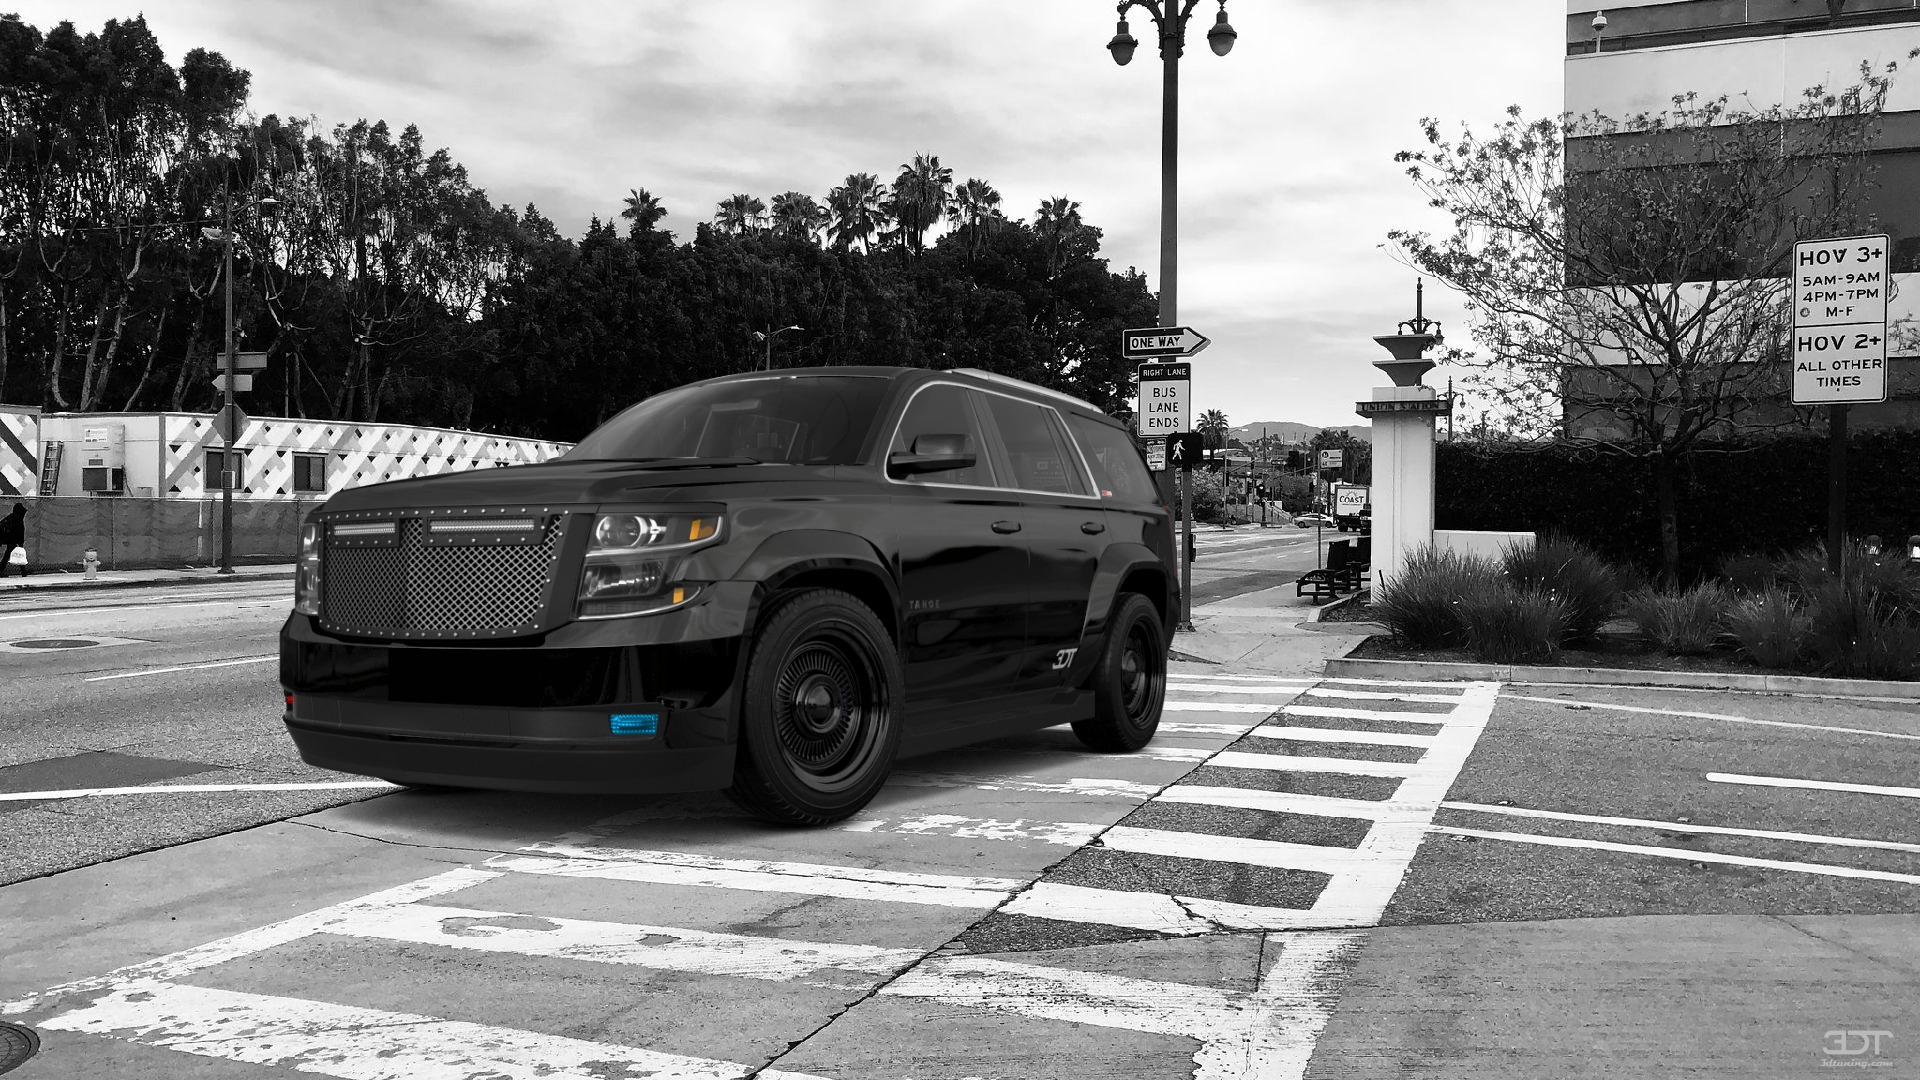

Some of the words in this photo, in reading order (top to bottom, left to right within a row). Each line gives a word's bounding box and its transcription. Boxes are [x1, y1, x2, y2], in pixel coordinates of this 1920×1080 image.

[1800, 248, 1848, 267] HOV
[1856, 246, 1883, 263] 3+
[1802, 271, 1880, 287] 5AM-9AM
[1802, 288, 1879, 303] 4PM-7PM
[1825, 305, 1855, 318] M-F
[1131, 338, 1154, 348] ONE
[1158, 336, 1180, 347] WAY
[1798, 335, 1846, 352] HOV
[1854, 333, 1882, 349] 2+
[1796, 361, 1827, 372] ALL
[1832, 358, 1882, 371] OTHER
[1143, 368, 1164, 377] RIGHT
[1167, 368, 1187, 376] LANE
[1816, 375, 1861, 387] TIMES
[1153, 387, 1176, 398] BUS
[1149, 401, 1179, 413] LANE
[1361, 403, 1395, 411] UNION
[1149, 417, 1179, 428] ENDS
[1339, 495, 1364, 503] COAST
[909, 599, 940, 609] TAHOE
